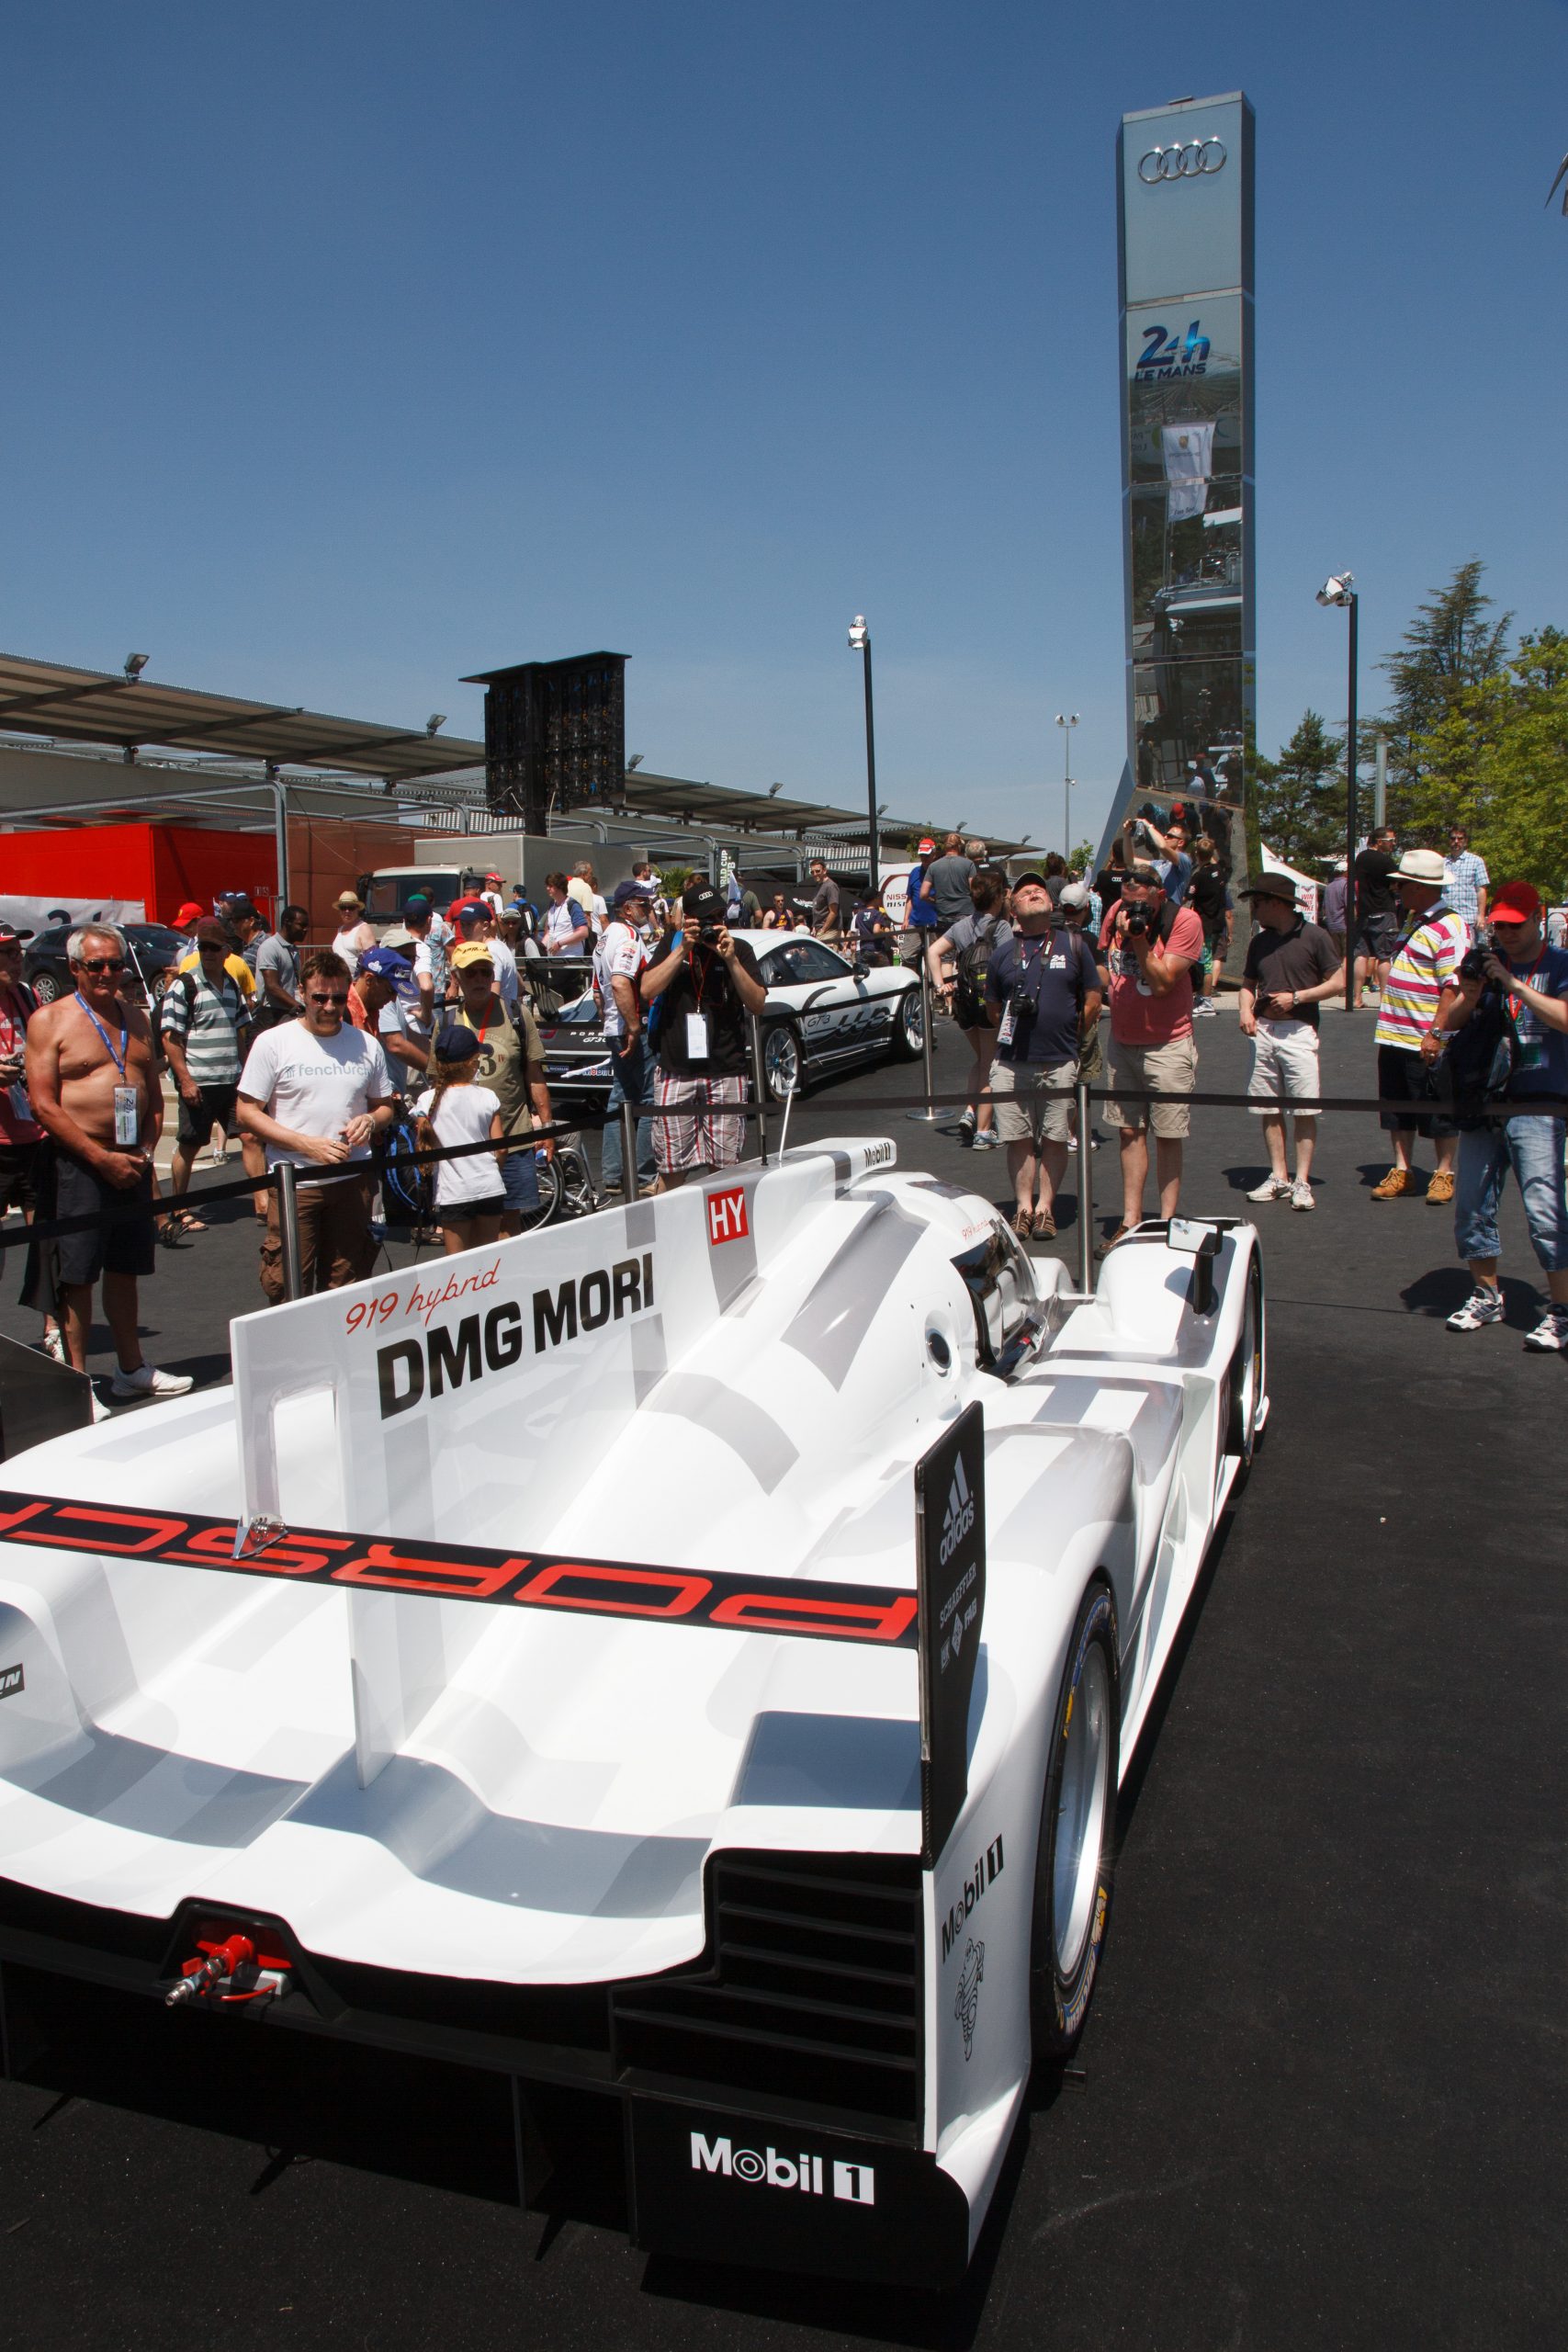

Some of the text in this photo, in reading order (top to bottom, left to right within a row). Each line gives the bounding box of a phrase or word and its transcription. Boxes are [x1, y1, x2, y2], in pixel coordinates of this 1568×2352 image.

[1136, 320, 1212, 368] 24h
[1134, 363, 1207, 383] LE MANS
[1051, 954, 1066, 962] 24
[808, 1014, 831, 1027] GT3
[863, 1141, 891, 1168] Mobil 1
[710, 1192, 745, 1242] HY
[962, 1226, 973, 1240] 919
[346, 1258, 502, 1335] 919 hybrid
[377, 1253, 654, 1420] DMG MORI
[940, 1498, 975, 1566] adidas
[940, 1561, 976, 1630] SCHAEFFLER
[942, 1833, 1004, 1964] Mobil 1
[691, 2132, 874, 2205] Mobil 1
